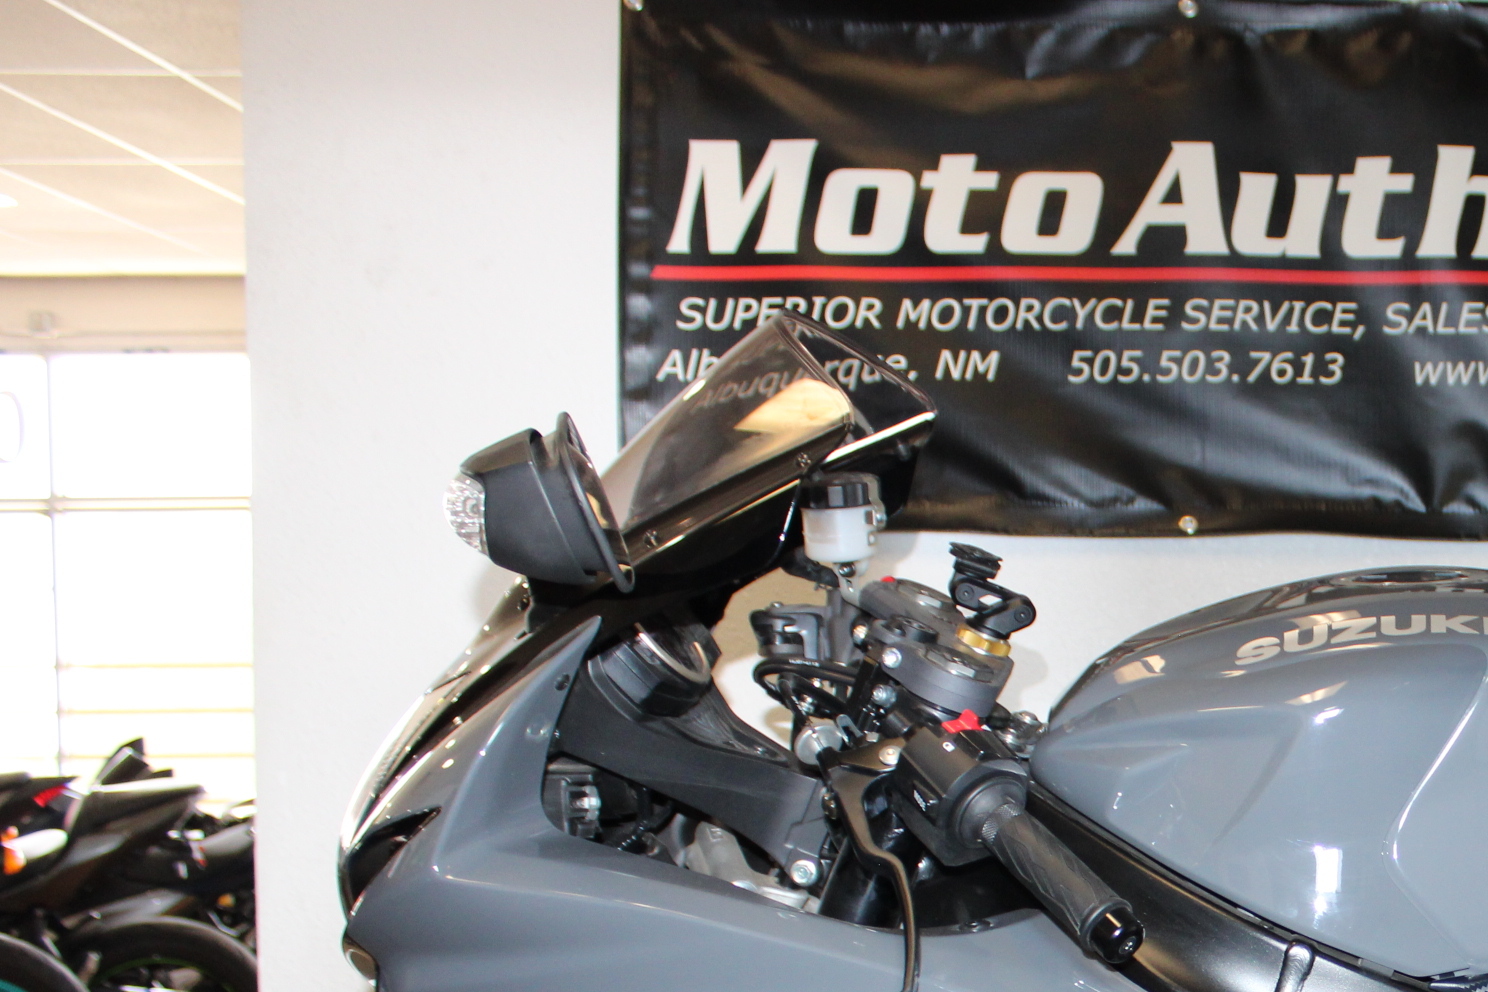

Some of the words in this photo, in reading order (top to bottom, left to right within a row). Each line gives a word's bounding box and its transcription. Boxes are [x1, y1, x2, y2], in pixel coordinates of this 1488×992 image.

[666, 138, 1104, 256] Moto
[896, 297, 1170, 332] MOTORCYCLE
[1181, 298, 1367, 341] SERVICE,
[934, 348, 1000, 383] NM
[1067, 349, 1346, 386] 505.503.7613
